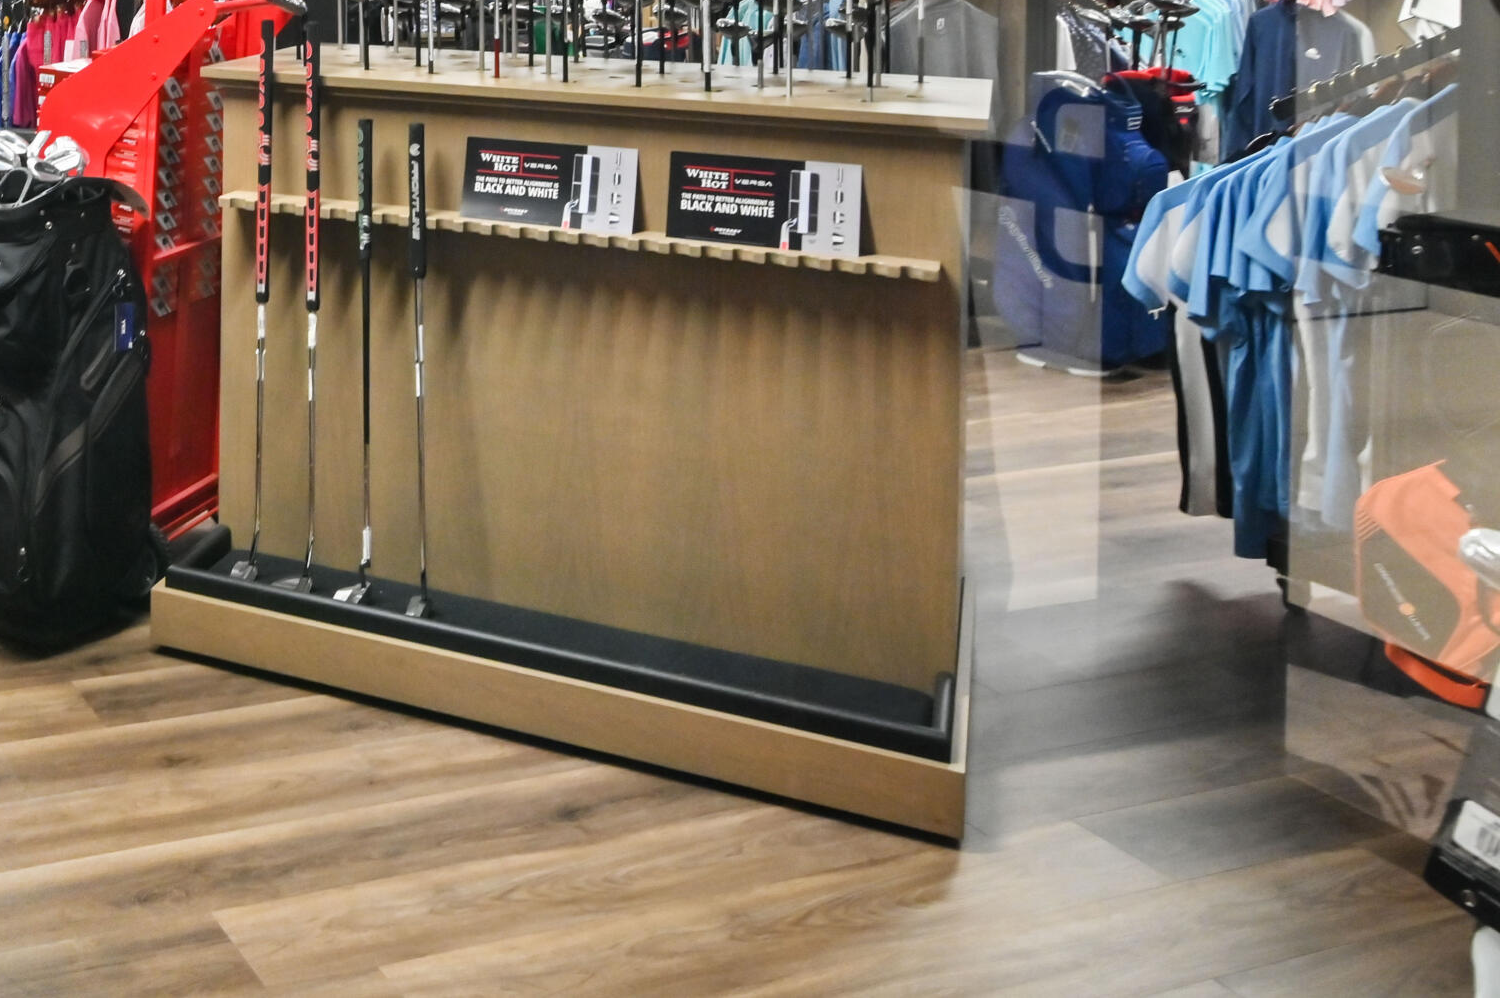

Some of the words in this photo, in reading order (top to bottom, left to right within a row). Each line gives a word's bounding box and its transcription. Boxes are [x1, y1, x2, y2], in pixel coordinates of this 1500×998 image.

[480, 152, 520, 165] WHITE
[493, 161, 519, 173] HOT
[523, 162, 558, 171] VERSA
[686, 168, 729, 180] WHITE
[523, 179, 553, 188] ALIGNMENT
[700, 178, 729, 189] HOT
[734, 178, 773, 187] VERSA
[474, 182, 503, 194] BLACK
[504, 184, 526, 196] AND
[527, 186, 559, 200] WHITE
[681, 192, 692, 200] THE
[692, 193, 706, 201] PATH
[715, 195, 734, 203] BETTER
[735, 196, 768, 206] ALIGNMENT
[768, 199, 775, 207] IS
[680, 199, 712, 212] BLACK
[713, 201, 738, 215] AND
[739, 204, 775, 218] WHITE
